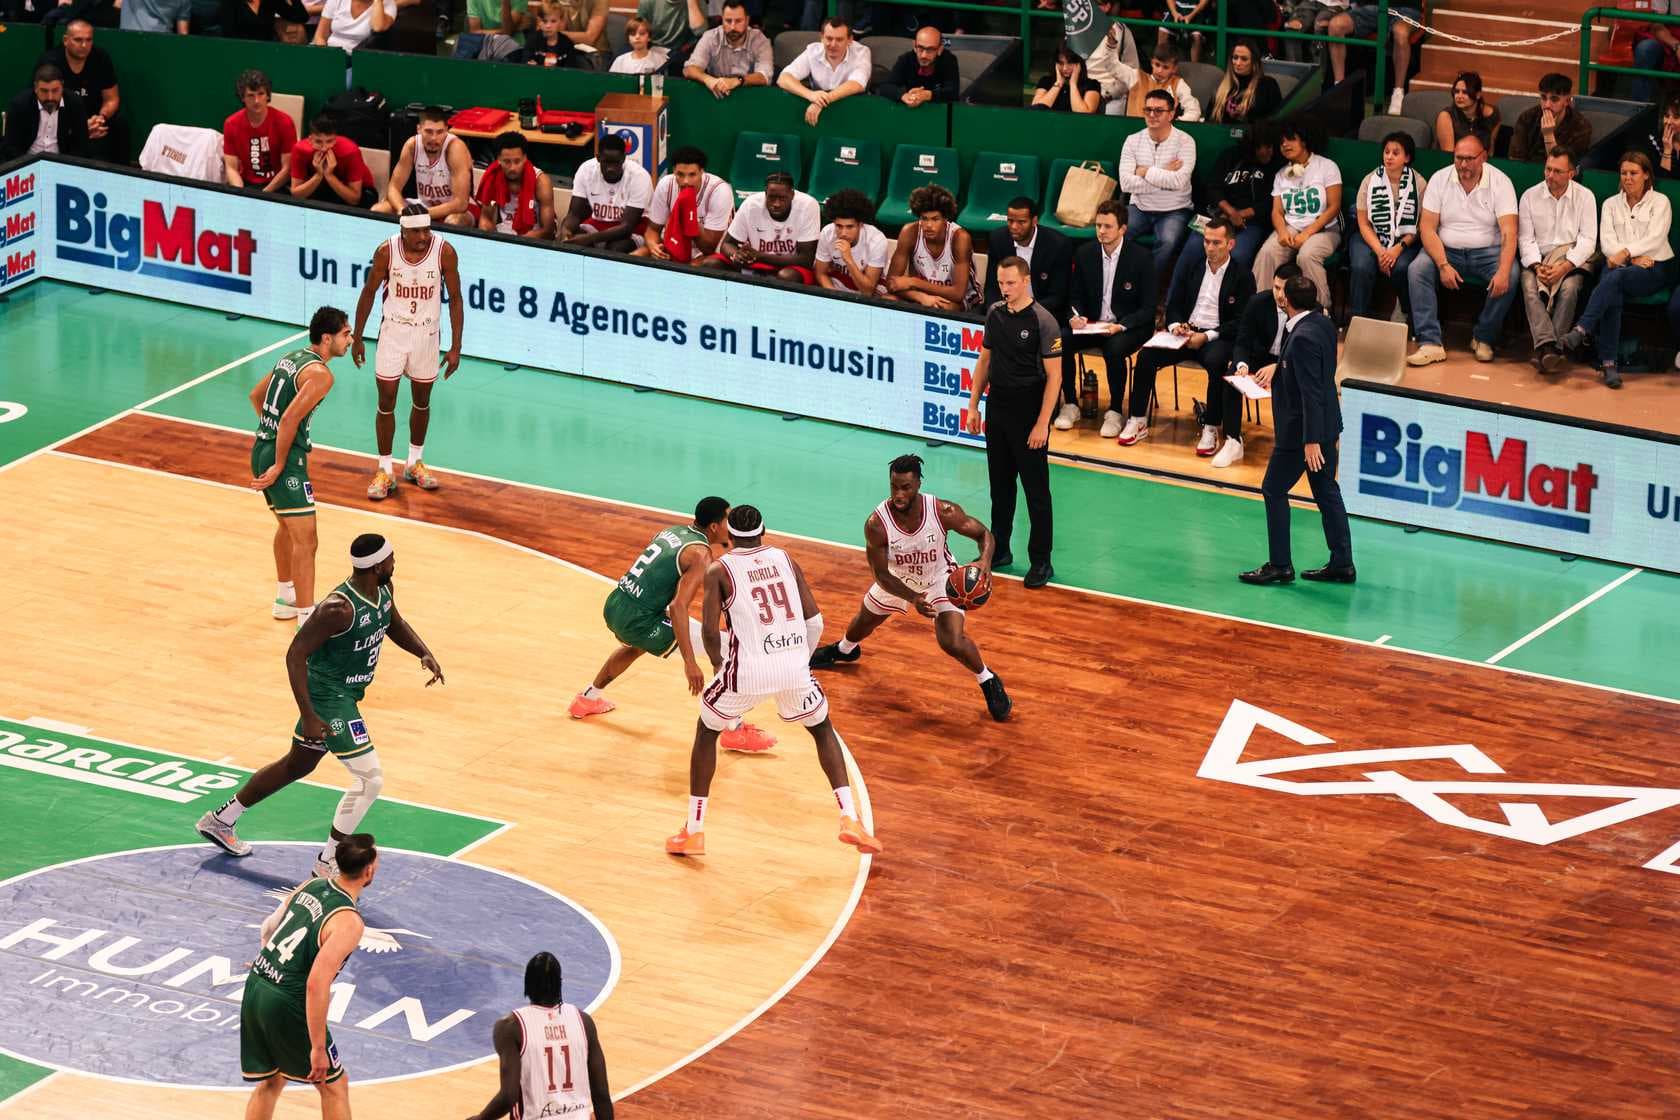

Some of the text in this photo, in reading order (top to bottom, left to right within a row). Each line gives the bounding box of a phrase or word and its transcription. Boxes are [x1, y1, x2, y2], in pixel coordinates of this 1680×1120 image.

[1283, 187, 1321, 215] 756
[56, 183, 257, 277] BigMat
[396, 282, 434, 300] BOURG
[410, 301, 417, 314] 3
[299, 247, 337, 284] Un
[469, 278, 505, 313] de
[519, 285, 538, 318] 8
[549, 291, 687, 345] Agences
[700, 324, 737, 354] en
[751, 326, 895, 383] Limousin
[925, 320, 984, 355] BigM
[1360, 412, 1598, 514] BigMat
[630, 543, 662, 577] 2
[895, 549, 937, 565] BOURG
[750, 582, 795, 625] 34
[267, 910, 308, 965] 14
[29, 969, 241, 1030] Immobi
[544, 1045, 574, 1091] 11
